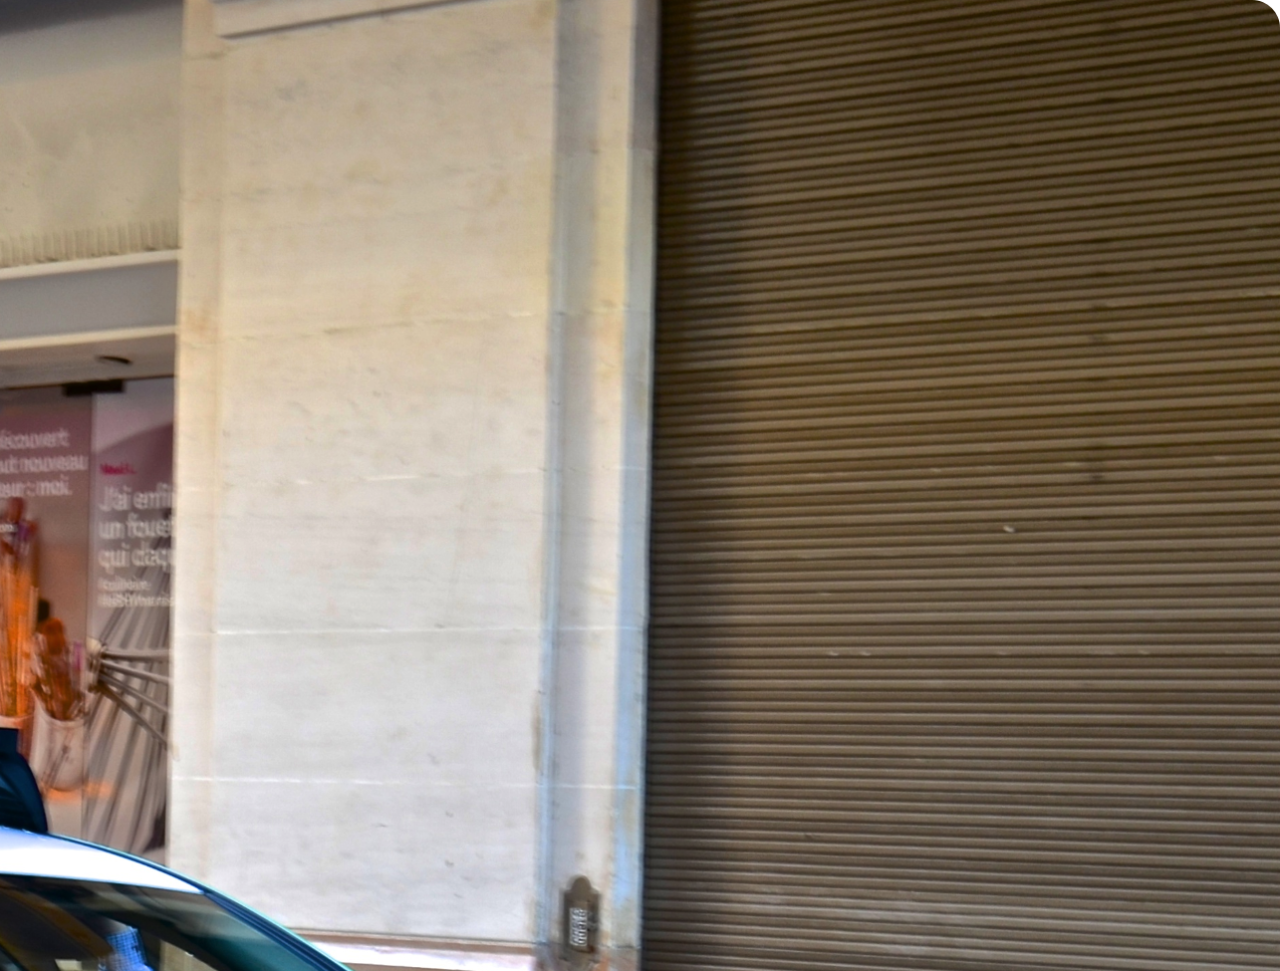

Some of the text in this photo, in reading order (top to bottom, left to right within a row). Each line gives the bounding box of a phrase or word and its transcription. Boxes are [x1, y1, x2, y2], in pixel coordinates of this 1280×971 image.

[20, 454, 89, 473] nouveau
[98, 481, 172, 512] J'ai enfi
[98, 511, 172, 539] un foue
[98, 541, 130, 575] qui
